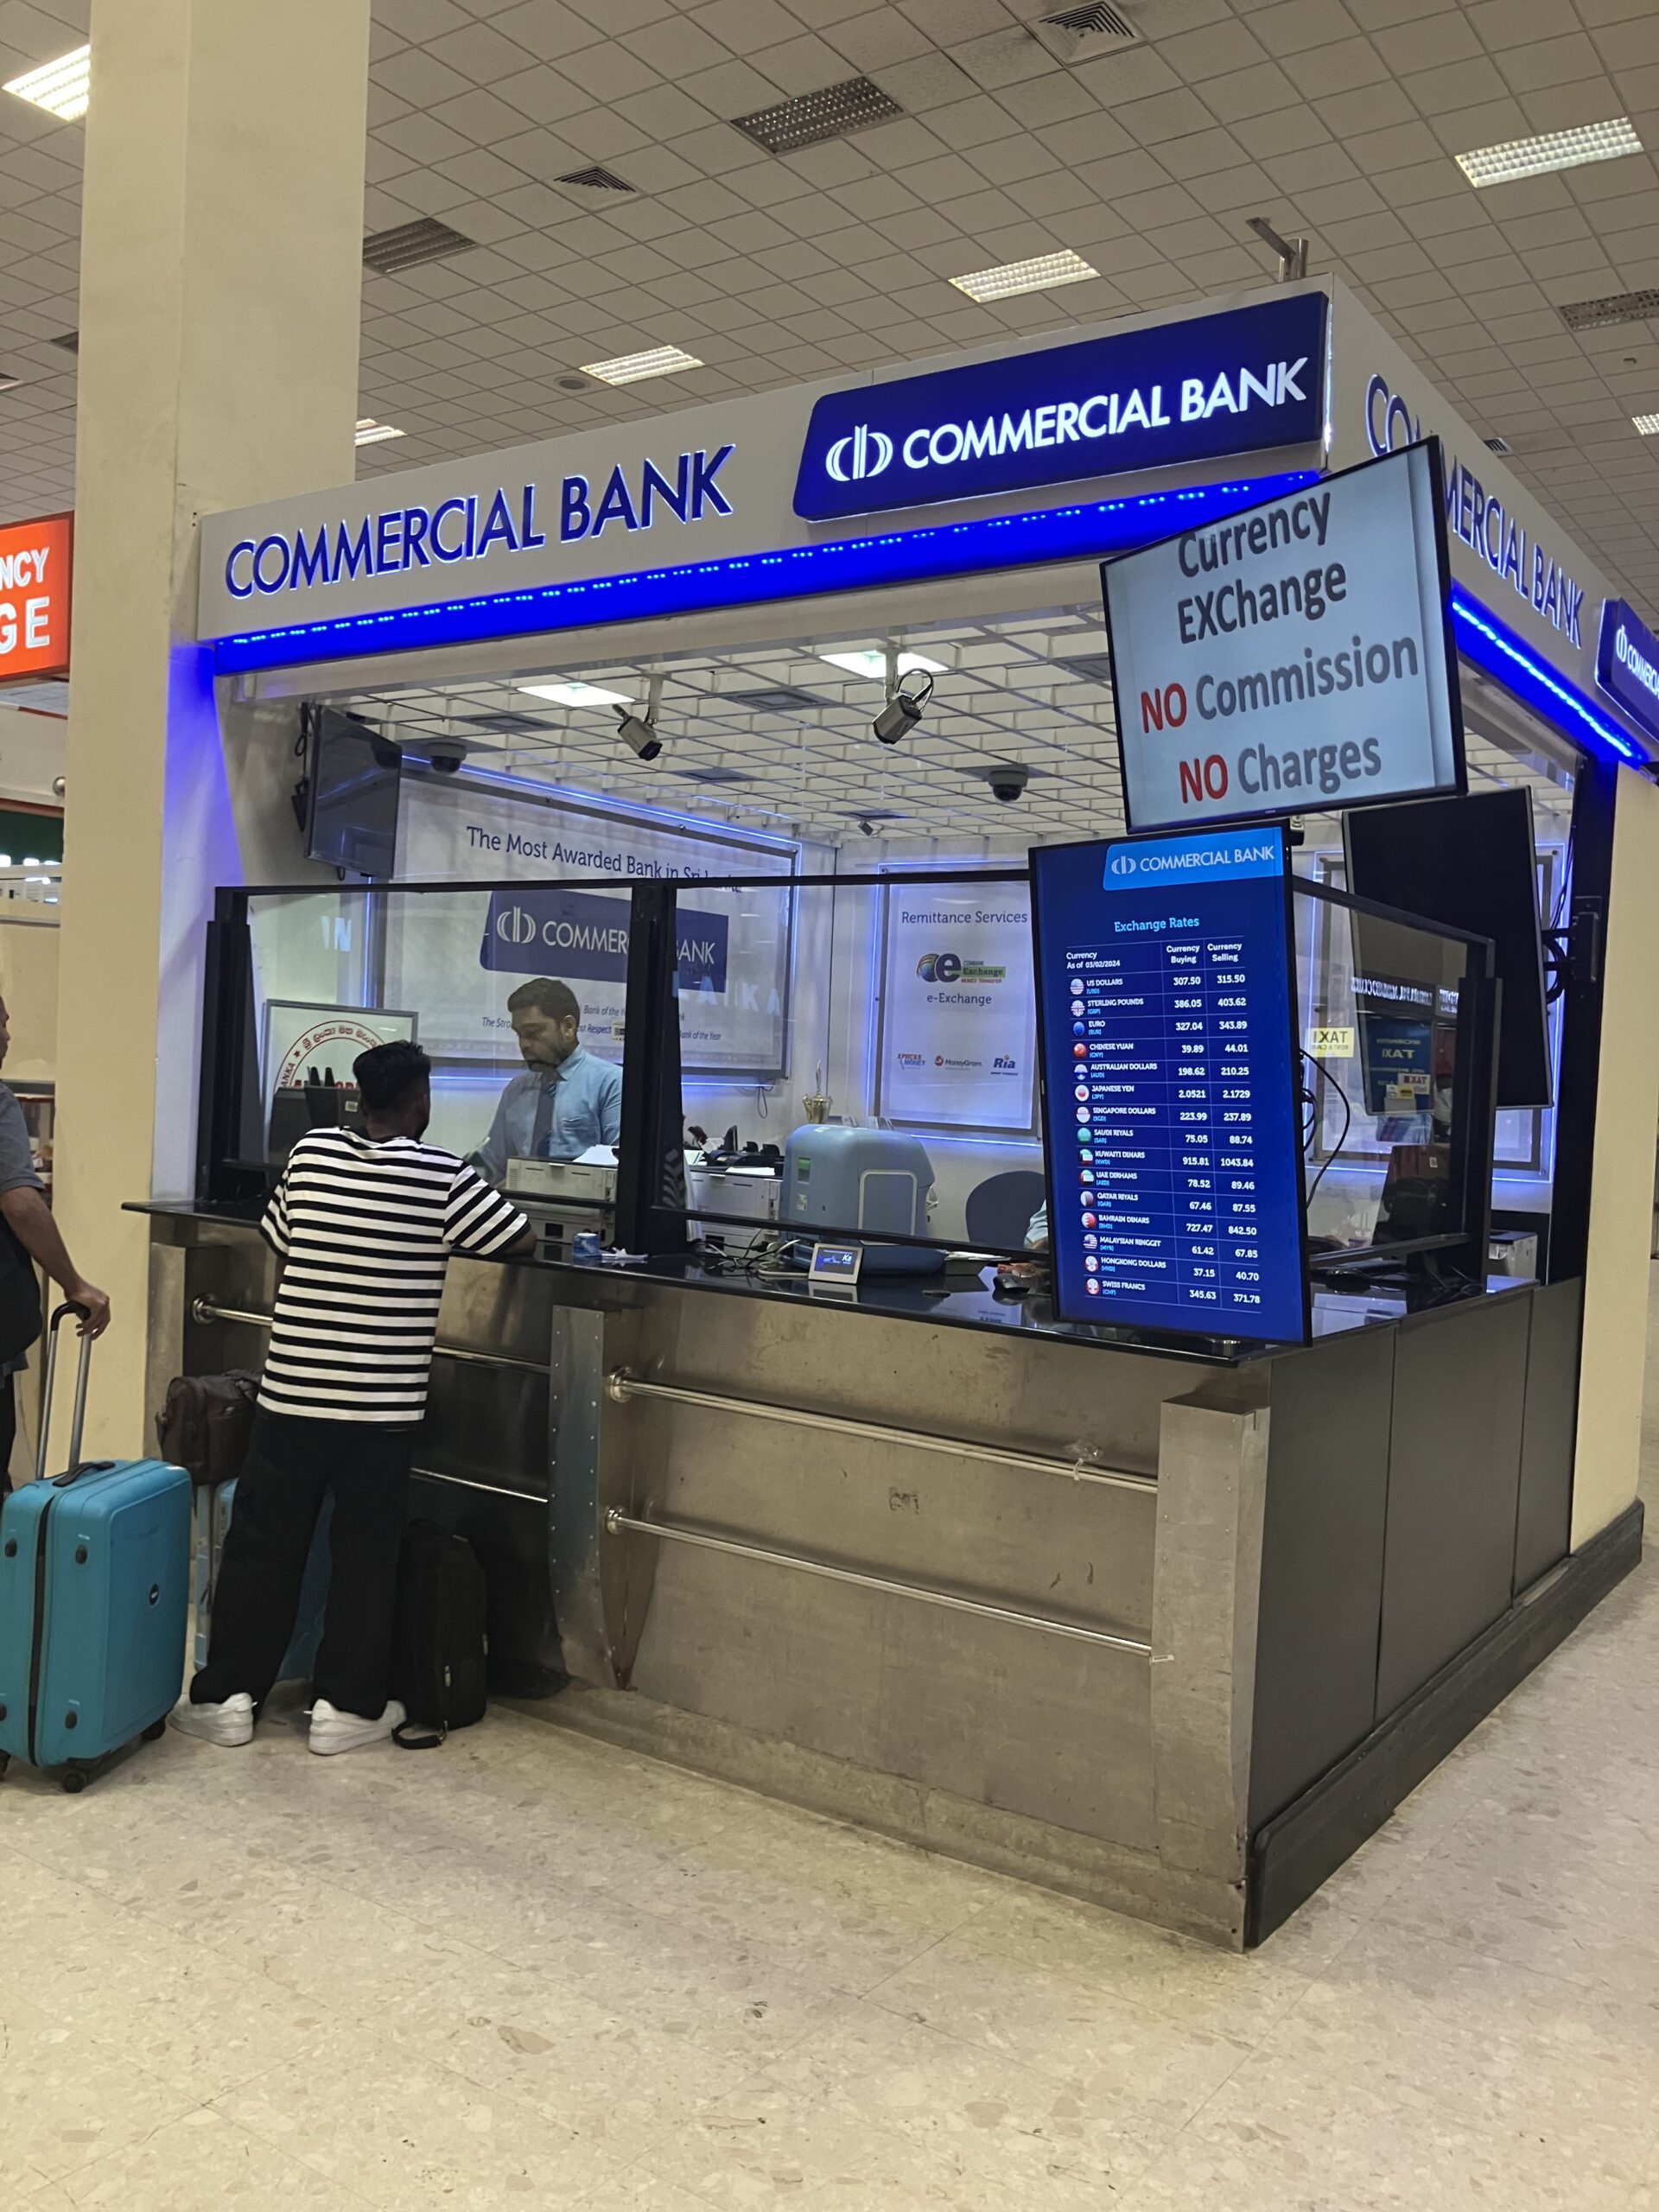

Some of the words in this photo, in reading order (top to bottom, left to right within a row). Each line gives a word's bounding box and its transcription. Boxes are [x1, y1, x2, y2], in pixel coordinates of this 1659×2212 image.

[903, 385, 1170, 470] COMMERCIAL
[1180, 356, 1308, 423] BANK
[1365, 373, 1528, 600] COMERCIAL
[1531, 542, 1584, 650] BANK
[226, 485, 545, 600] COMMERCIAL
[560, 442, 736, 544] BANK
[1179, 492, 1331, 578] Currency
[1178, 562, 1348, 644] EXChange
[1141, 683, 1188, 734] NO
[1195, 631, 1418, 722] Commission
[1179, 753, 1229, 804] NO
[1236, 735, 1383, 800] Charges
[467, 825, 501, 850] The
[506, 833, 548, 860] Most
[552, 842, 622, 873] Awarded
[626, 855, 662, 878] Bank
[666, 863, 679, 878] in
[1140, 850, 1230, 872] COMMERCIAL
[1234, 845, 1274, 862] BANK
[901, 912, 971, 924] Remittance
[975, 911, 1027, 923] Services
[1115, 918, 1166, 932] Exchange
[1169, 917, 1199, 929] Rates
[543, 920, 628, 954] COMMER
[1166, 944, 1200, 953] Currency
[1207, 943, 1243, 951] Currency
[1066, 951, 1097, 960] Currency
[1171, 955, 1197, 964] Buying
[1212, 954, 1239, 963] Selling
[1085, 960, 1121, 969] 03/02/2024
[963, 968, 1003, 977] Exchange
[1173, 976, 1201, 986] 307.50
[1217, 975, 1246, 984] 315.50
[927, 993, 992, 1007] e-Exchange
[1174, 1000, 1202, 1008] 386.05
[1217, 998, 1247, 1007] 403.62
[583, 1004, 601, 1014] Bank
[601, 1005, 609, 1014] of
[609, 1006, 620, 1016] the
[482, 1017, 495, 1027] The
[1175, 1022, 1203, 1031] 327.04
[1219, 1020, 1248, 1029] 343.89
[1181, 1045, 1204, 1053] 39.89
[1224, 1044, 1249, 1052] 44.01
[944, 1058, 982, 1067] MoneyGram
[993, 1055, 1016, 1069] Ria
[1178, 1067, 1205, 1076] 198.62
[1221, 1066, 1249, 1076] 210.25
[1179, 1090, 1206, 1098] 2.0521
[1223, 1090, 1250, 1098] 2.1729
[1179, 1112, 1207, 1121] 223.99
[1224, 1113, 1252, 1122] 237.89
[1185, 1135, 1208, 1143] 75.05
[1229, 1135, 1253, 1144] 88.74
[1182, 1157, 1210, 1166] 915.81
[1220, 1158, 1254, 1167] 1043.84
[1187, 1179, 1211, 1188] 78.52
[1231, 1181, 1255, 1190] 89.46
[1189, 1201, 1211, 1211] 67.46
[1232, 1203, 1255, 1212] 87.55
[1098, 1214, 1126, 1223] BAHRAIN
[1185, 1223, 1213, 1232] 727.47
[1228, 1225, 1257, 1236] 842.50
[1100, 1236, 1135, 1245] MALAYSIAN
[1192, 1246, 1214, 1255] 61.42
[1235, 1249, 1258, 1258] 67.85
[1138, 1259, 1166, 1268] DOLLARS
[1193, 1268, 1215, 1277] 37.15
[1236, 1271, 1259, 1281] 40.70
[1189, 1290, 1217, 1300] 345.63
[1233, 1294, 1261, 1303] 371.78
